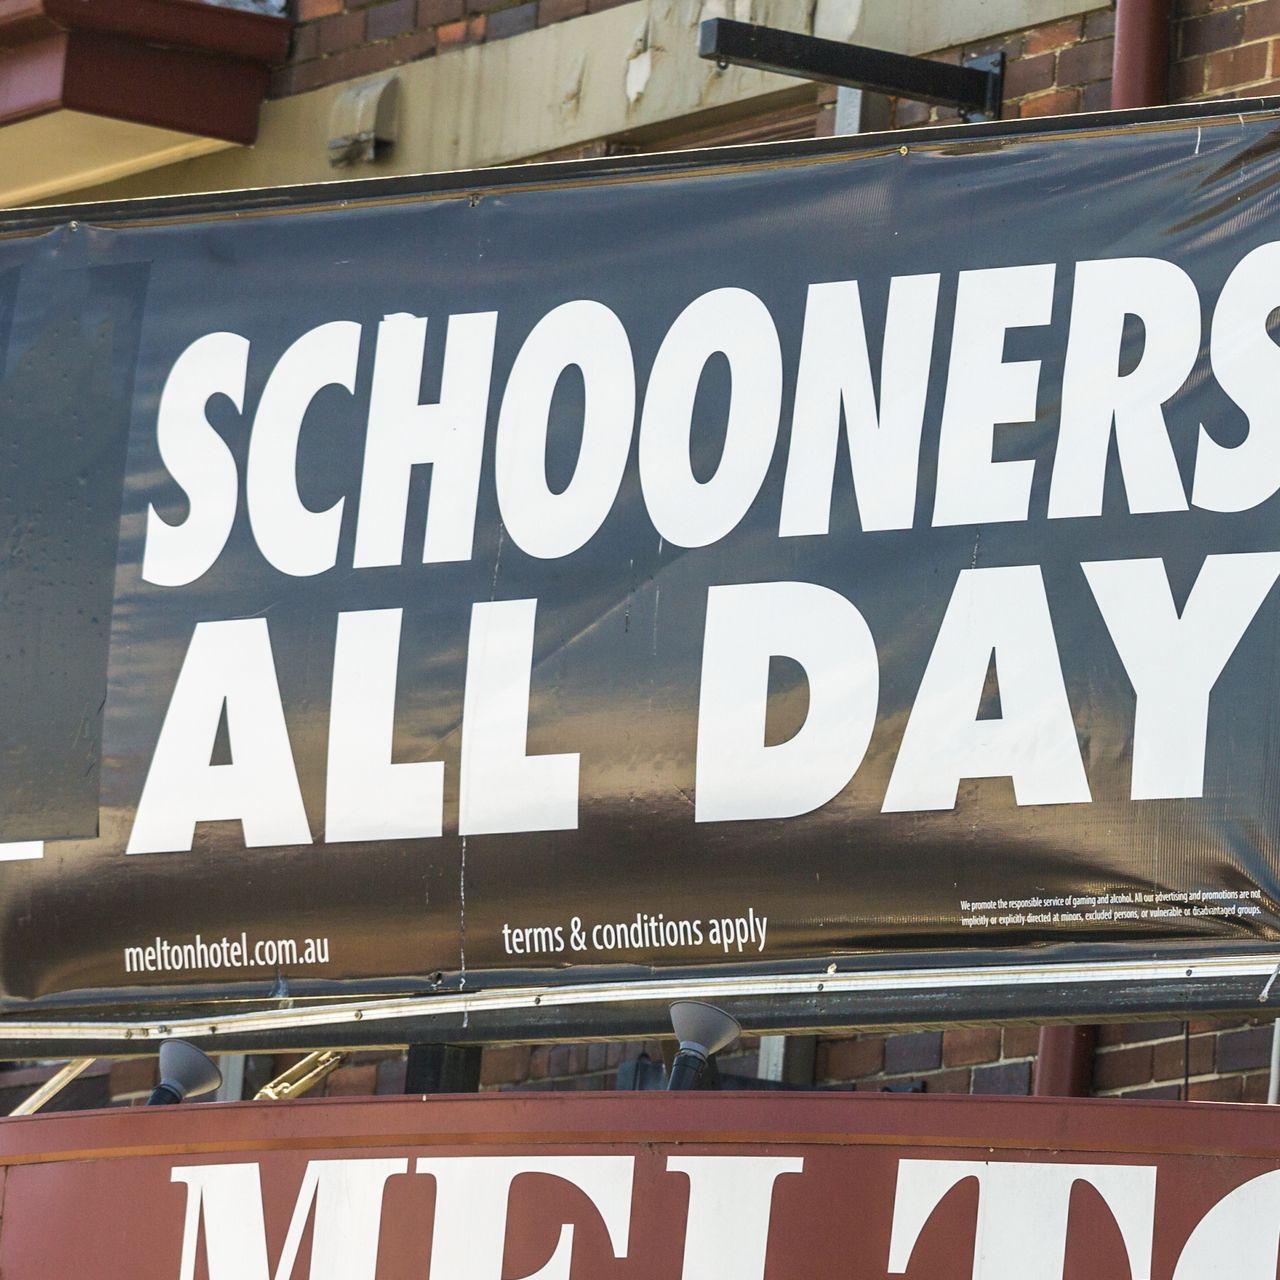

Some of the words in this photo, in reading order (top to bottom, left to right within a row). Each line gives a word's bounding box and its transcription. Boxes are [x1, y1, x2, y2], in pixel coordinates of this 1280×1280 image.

[126, 599, 580, 854] ALL
[960, 900, 970, 910] We
[972, 900, 997, 911] promote
[998, 899, 1007, 909] the
[1009, 897, 1042, 910] responsible
[1044, 896, 1064, 907] service
[1065, 895, 1072, 906] of
[1073, 895, 1096, 908] gaming
[1097, 894, 1109, 904] and
[1110, 893, 1133, 904] alcohol.
[1143, 894, 1154, 903] our
[1155, 891, 1188, 904] advertising
[1189, 890, 1200, 900] and
[1201, 889, 1238, 901] promotions
[1239, 891, 1249, 899] are
[1251, 889, 1261, 898] not
[961, 915, 989, 927] implicitly
[991, 916, 997, 924] or
[999, 913, 1025, 926] explicitly
[1026, 912, 1051, 923] directed
[1052, 912, 1059, 922] at
[1060, 912, 1083, 922] minors,
[1085, 909, 1112, 920] excluded
[1114, 909, 1139, 921] persons,
[1141, 910, 1148, 918] or
[1150, 906, 1182, 917] vulnerable
[1184, 908, 1191, 916] or
[1193, 905, 1236, 918] disadvantaged
[1238, 905, 1261, 916] groups.
[502, 924, 564, 953] terms
[570, 917, 587, 951] &
[593, 913, 703, 949] conditions
[709, 908, 767, 952] apply
[125, 933, 329, 972] meltonhotel.com.au
